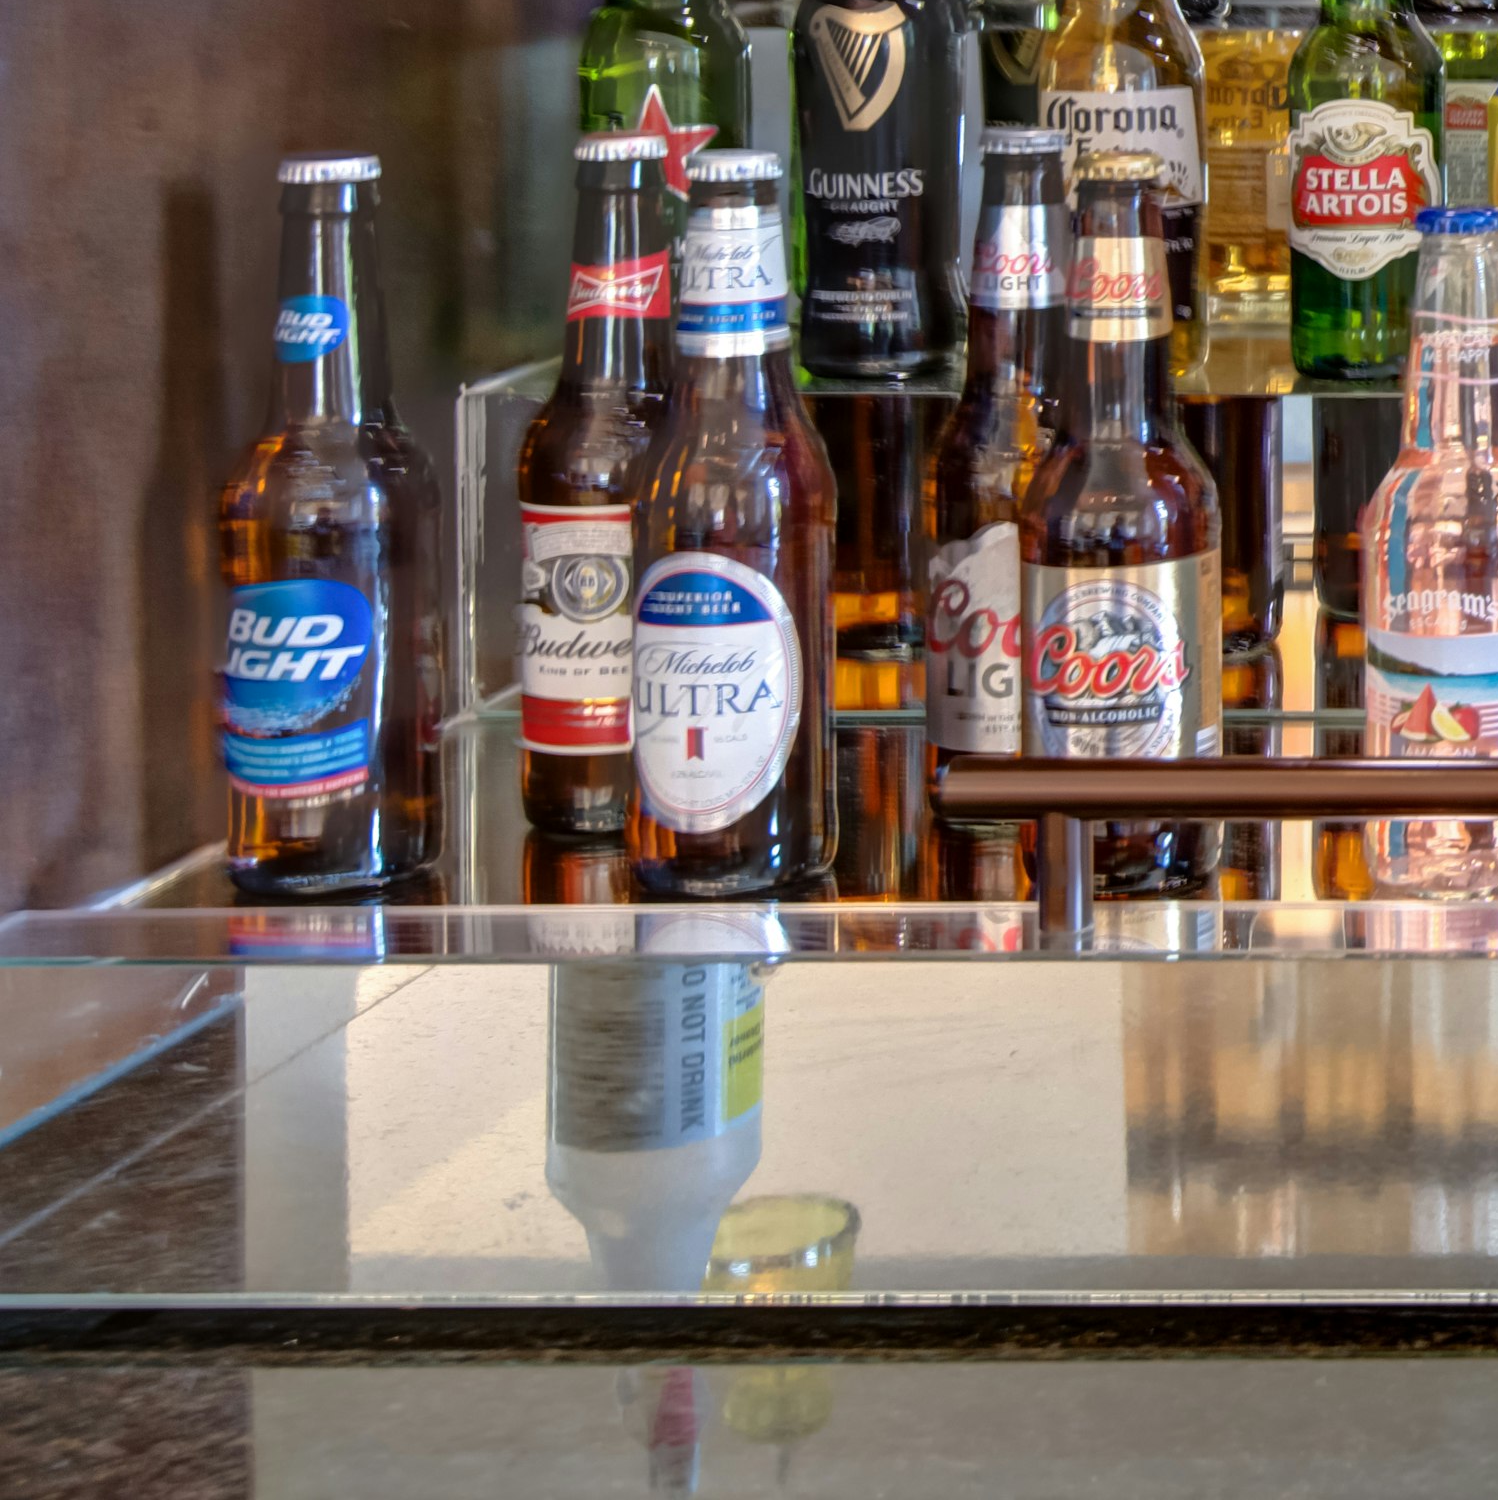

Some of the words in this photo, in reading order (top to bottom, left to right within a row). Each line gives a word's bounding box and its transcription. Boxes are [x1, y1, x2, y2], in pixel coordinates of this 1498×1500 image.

[1046, 96, 1178, 134] Corona
[807, 168, 924, 199] GUINNESS
[1306, 167, 1406, 190] STELLA
[830, 200, 899, 213] DRAUGHT
[1306, 192, 1408, 216] ARTOIS
[1348, 234, 1379, 246] Lager
[1065, 257, 1163, 302] Coors
[279, 309, 333, 328] BUD
[702, 602, 741, 614] BEER
[229, 608, 344, 648] BUD
[522, 623, 632, 661] Budwe
[226, 644, 366, 682] IGHT
[539, 665, 568, 677] KING
[573, 668, 592, 676] OF
[646, 649, 758, 675] Michelob
[1031, 624, 1190, 700] Coors
[637, 677, 784, 718] ULTRA
[1052, 705, 1160, 723] NON-ALCOHOLIC
[681, 993, 706, 1043] NOT
[680, 1051, 706, 1133] DRINK
